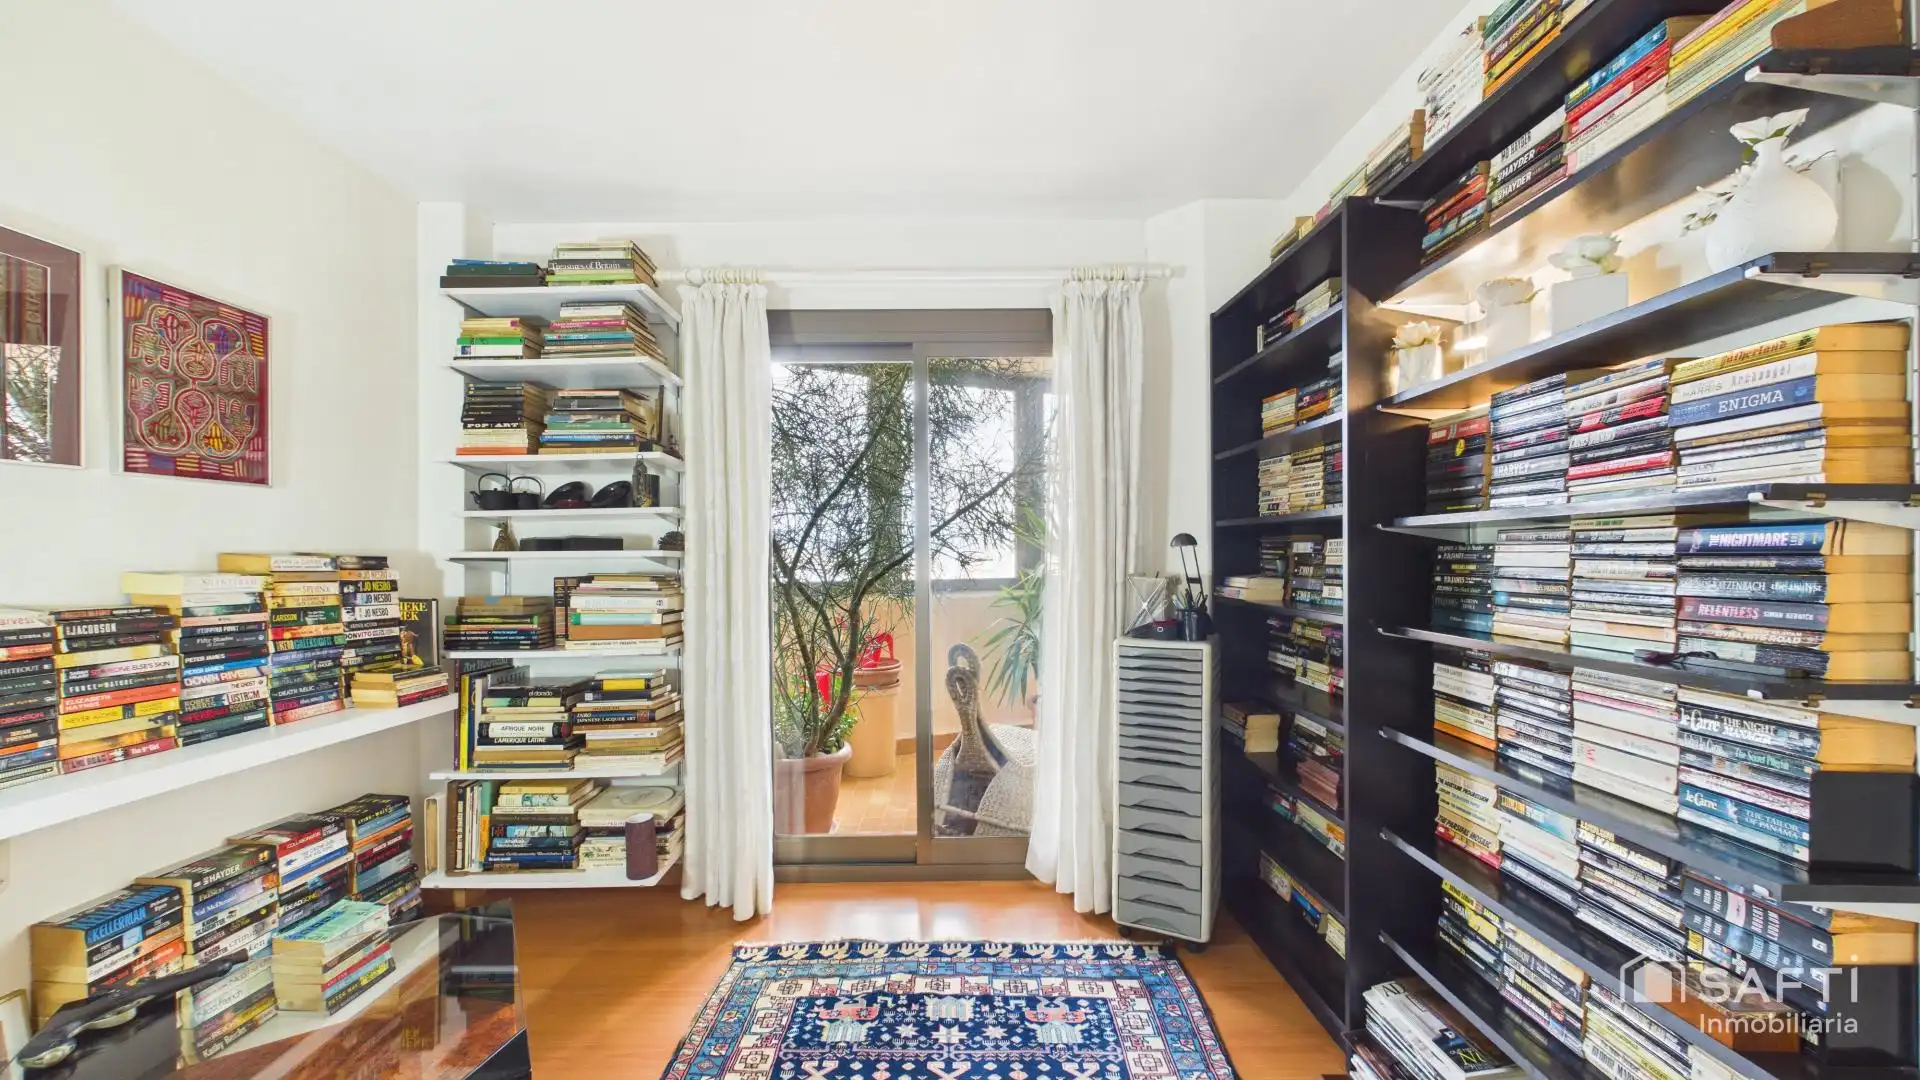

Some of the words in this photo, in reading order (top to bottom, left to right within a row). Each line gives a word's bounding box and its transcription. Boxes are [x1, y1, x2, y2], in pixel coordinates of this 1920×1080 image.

[1502, 150, 1535, 179] HAYDER
[1502, 171, 1532, 198] HAYDER
[1718, 390, 1785, 413] ENIGMA
[1719, 533, 1789, 547] NIGHTMARE
[1698, 604, 1759, 620] RELENTLESS
[1769, 633, 1802, 644] ROAD
[206, 653, 226, 661] JAMES
[132, 662, 153, 671] ELSE'S
[154, 660, 171, 669] SKIN
[184, 668, 204, 676] PETER
[205, 665, 225, 673] JAMES
[69, 684, 98, 693] FORCE
[104, 679, 133, 688] NATURE
[184, 673, 219, 687] DOWN
[278, 689, 298, 697] DEATH
[65, 695, 112, 706] ELIZABETH
[65, 702, 100, 712] HAYNES
[1681, 708, 1690, 726] le
[1722, 716, 1742, 730] THE
[1743, 720, 1777, 735] NIGHT
[1685, 789, 1694, 801] le
[1745, 809, 1764, 820] THE
[1765, 815, 1800, 832] TAILOR
[1745, 817, 1757, 826] OF
[1757, 822, 1799, 841] PANAMA
[209, 863, 240, 884] HAYDER
[92, 905, 147, 942] KELLERMAN
[1751, 903, 1765, 934] ROBERT
[1766, 910, 1781, 942] LUDLUM
